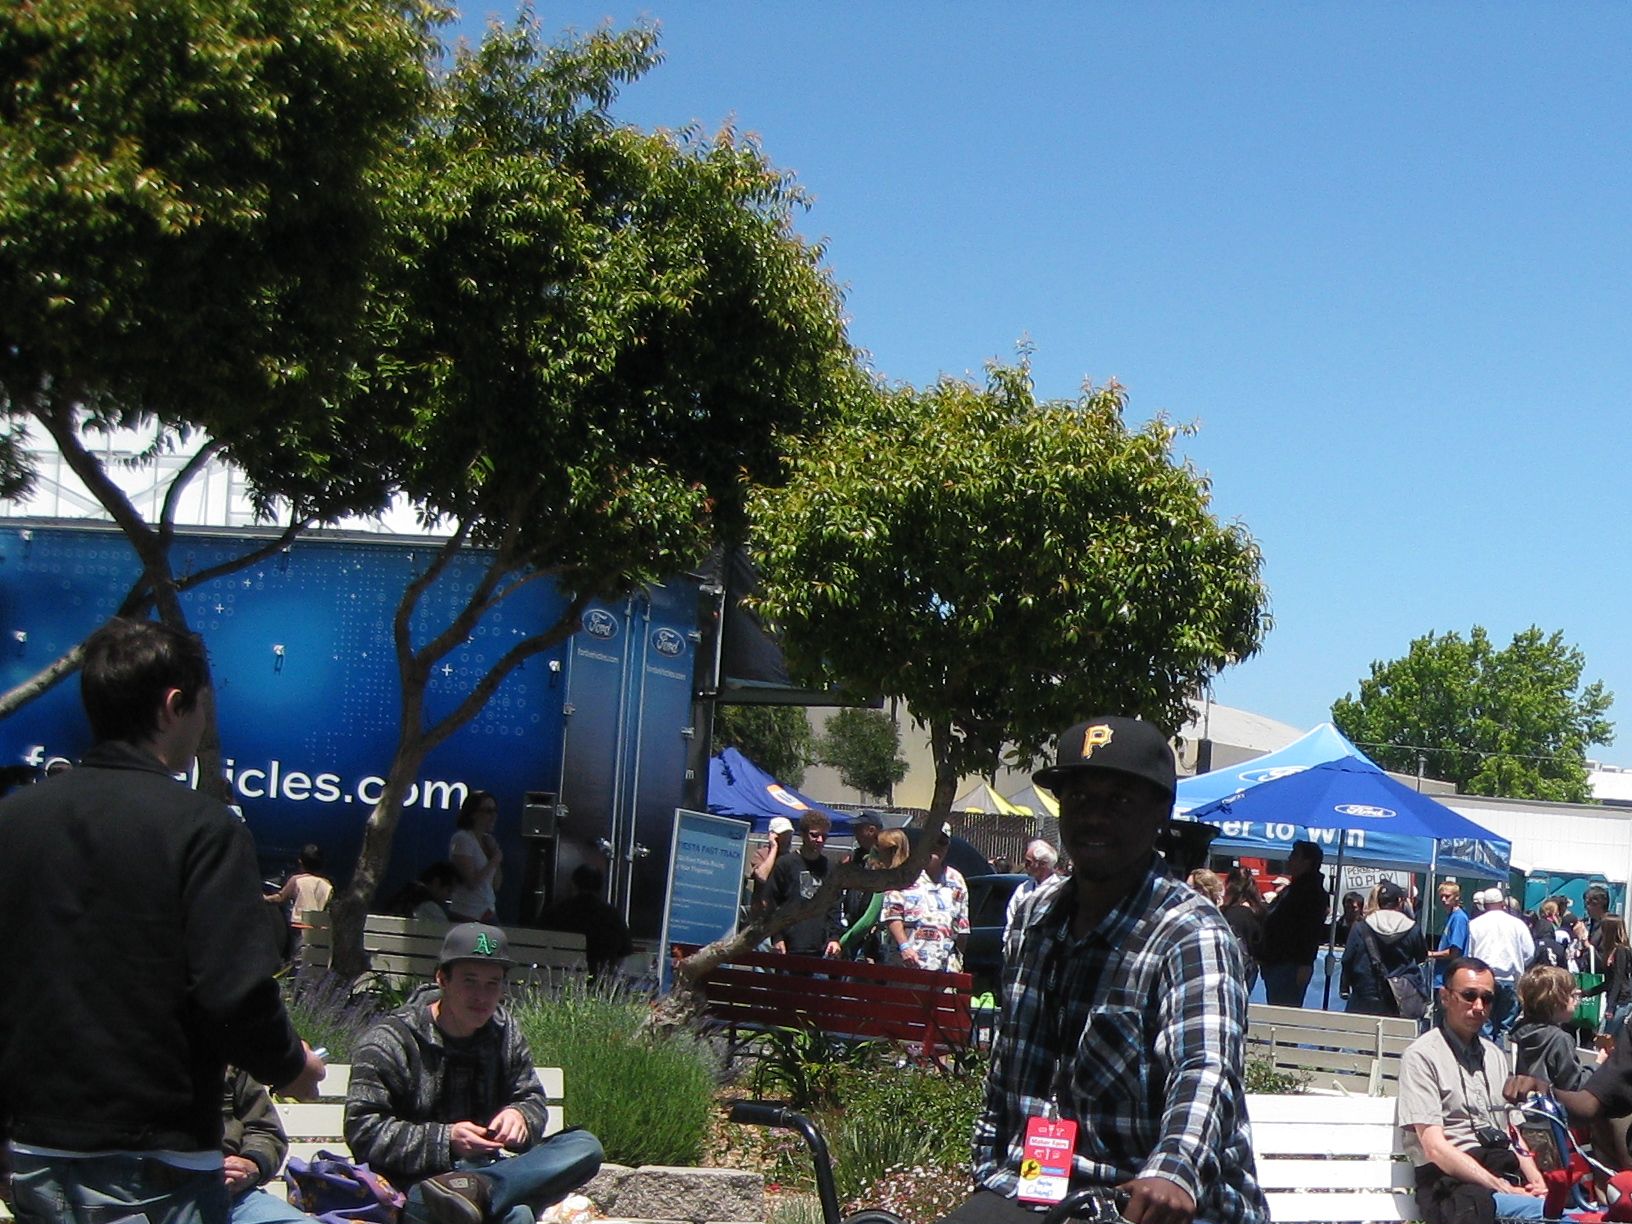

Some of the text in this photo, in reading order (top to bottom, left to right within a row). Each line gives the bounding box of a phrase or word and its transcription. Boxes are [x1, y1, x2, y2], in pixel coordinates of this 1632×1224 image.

[588, 611, 613, 636] Ford
[656, 630, 680, 654] Ford
[1081, 724, 1114, 760] P
[1346, 804, 1384, 818] Ford
[1348, 876, 1363, 887] TO
